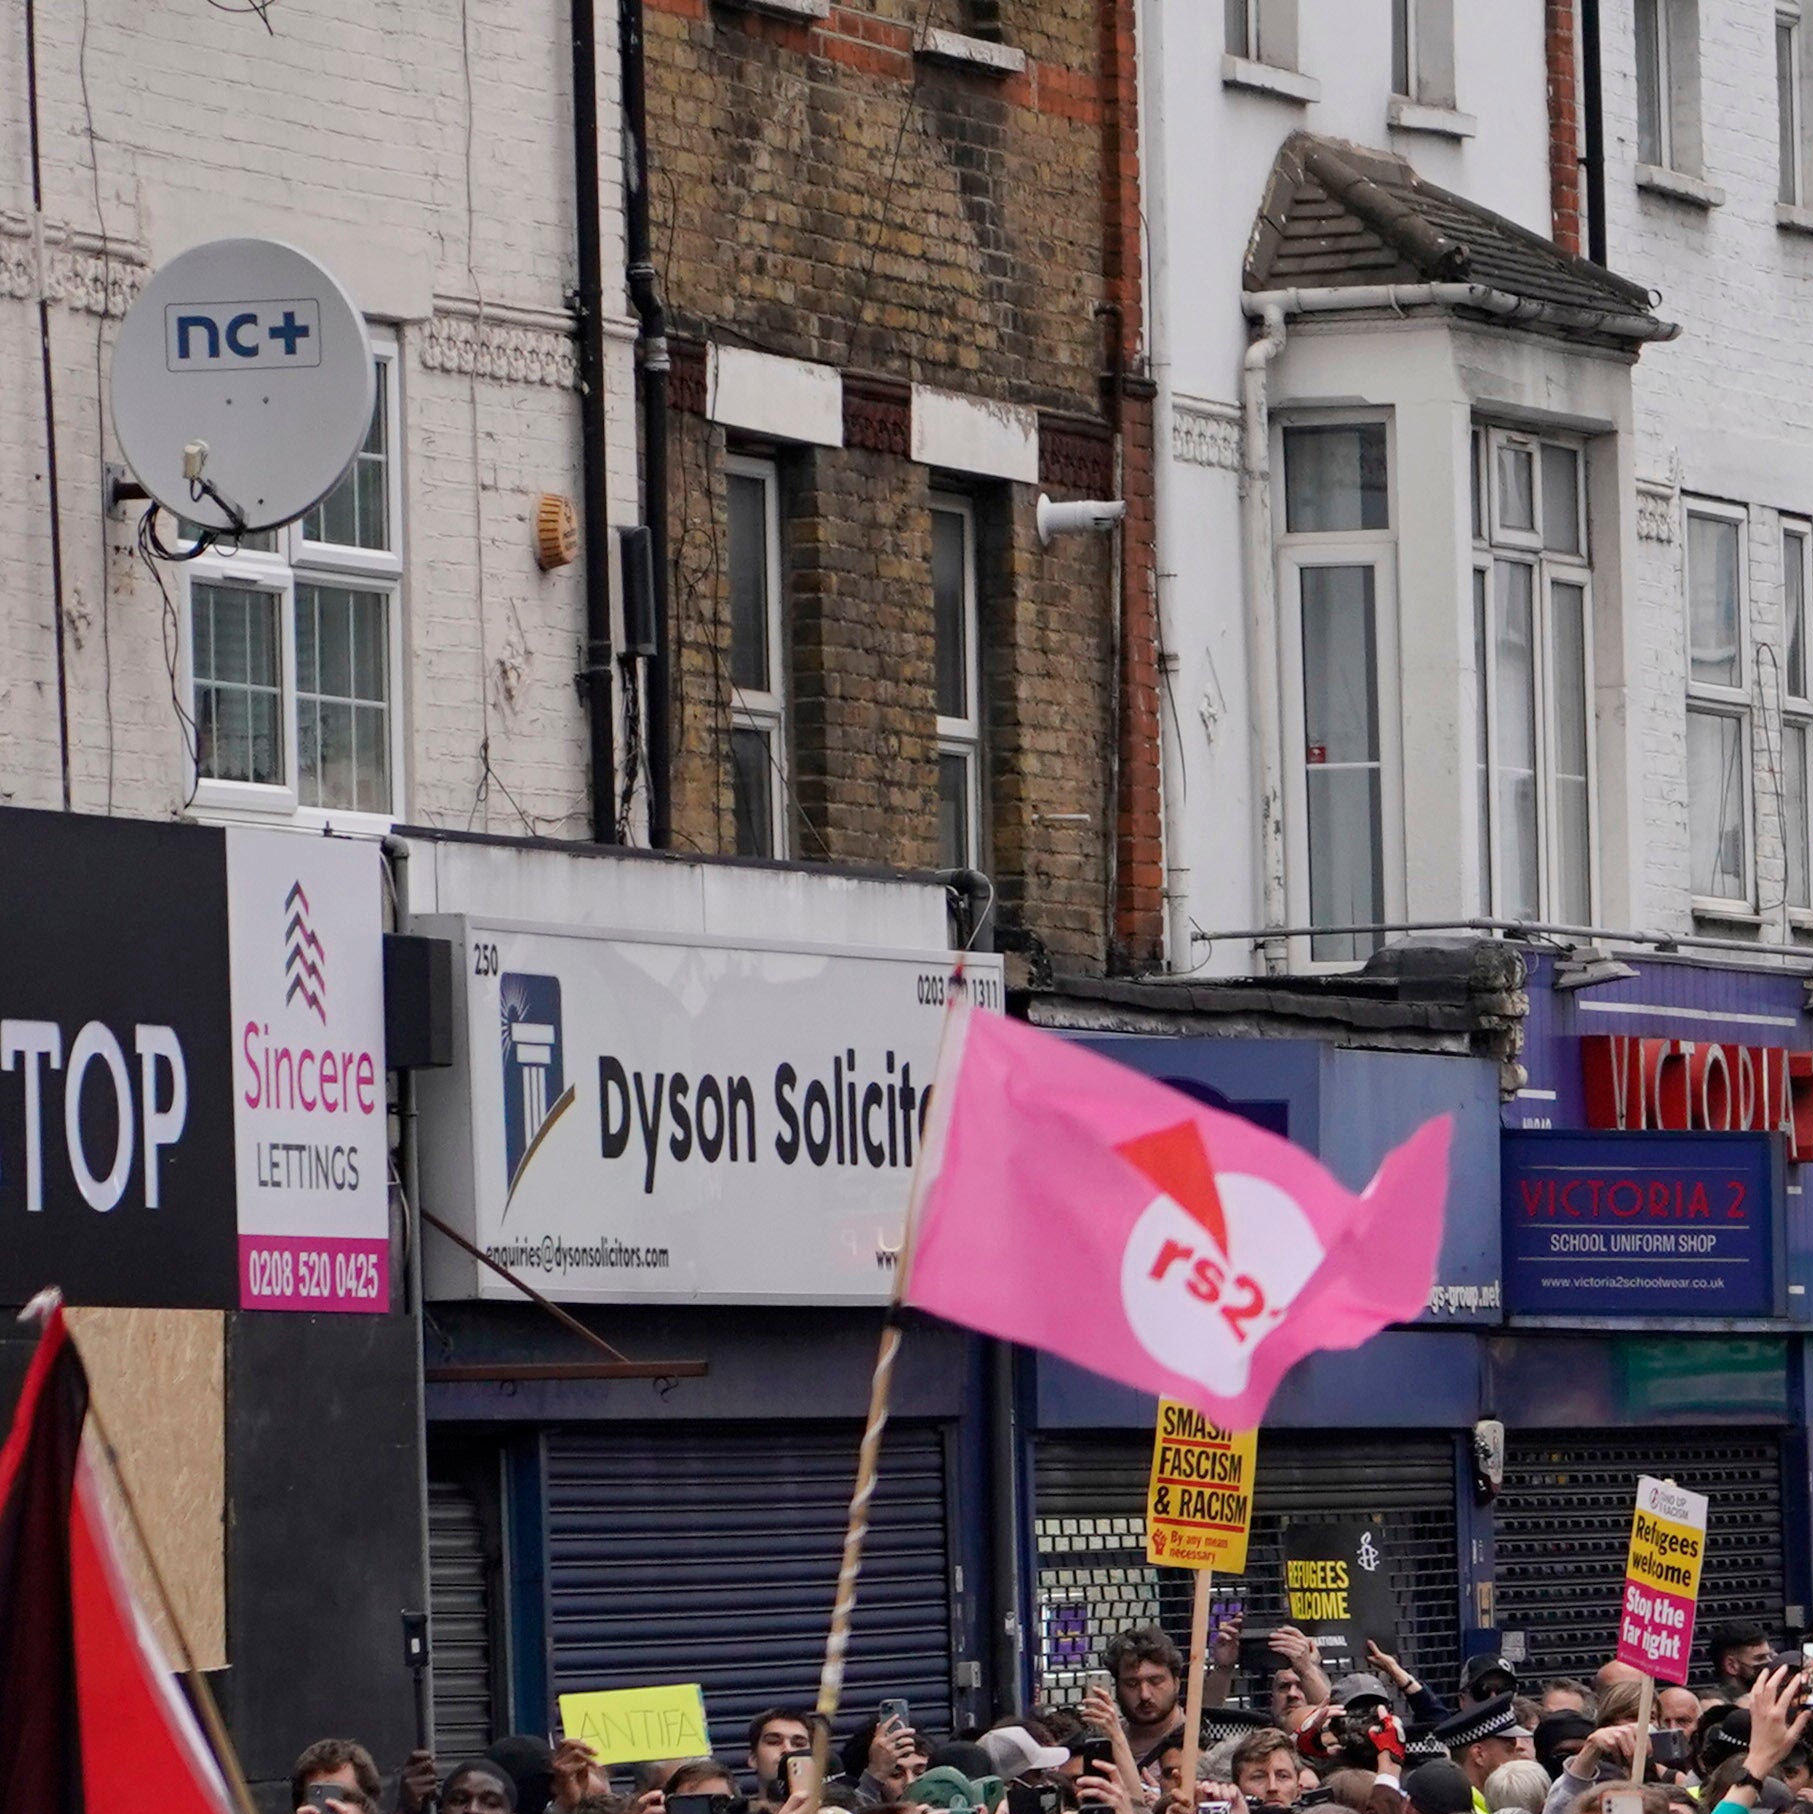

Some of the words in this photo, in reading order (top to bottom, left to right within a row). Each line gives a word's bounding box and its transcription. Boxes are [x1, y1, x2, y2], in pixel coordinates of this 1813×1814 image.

[177, 311, 310, 359] nc+
[474, 943, 499, 976] 250
[917, 974, 945, 1006] 0203
[972, 979, 998, 1009] 1311
[243, 1021, 375, 1115] Sincere
[0, 1019, 188, 1212] TOP
[599, 1055, 757, 1194] Dyson
[257, 1142, 359, 1191] LETTINGS
[1521, 1180, 1710, 1217] VICTORIA
[1728, 1181, 1746, 1218] 2
[1550, 1234, 1607, 1253] SCHOOL
[1611, 1234, 1675, 1253] UNIFORM
[1679, 1234, 1716, 1253] SHOP
[250, 1250, 294, 1297] 0208
[299, 1252, 330, 1298] 520
[336, 1252, 378, 1298] 0425
[1541, 1277, 1725, 1289] www.victoria2schoolwear.co.uk
[1159, 1447, 1243, 1484] FASCISM
[1153, 1485, 1171, 1516] &
[1179, 1489, 1249, 1524] RACISM
[1635, 1514, 1698, 1558] Refugees
[1287, 1560, 1349, 1589] REFUGEES
[1288, 1592, 1351, 1620] WELCOME
[1626, 1585, 1652, 1625] Stop
[1654, 1598, 1685, 1629] the
[1622, 1616, 1642, 1647] far
[1643, 1626, 1681, 1660] right
[578, 1705, 706, 1748] ANTIFA
